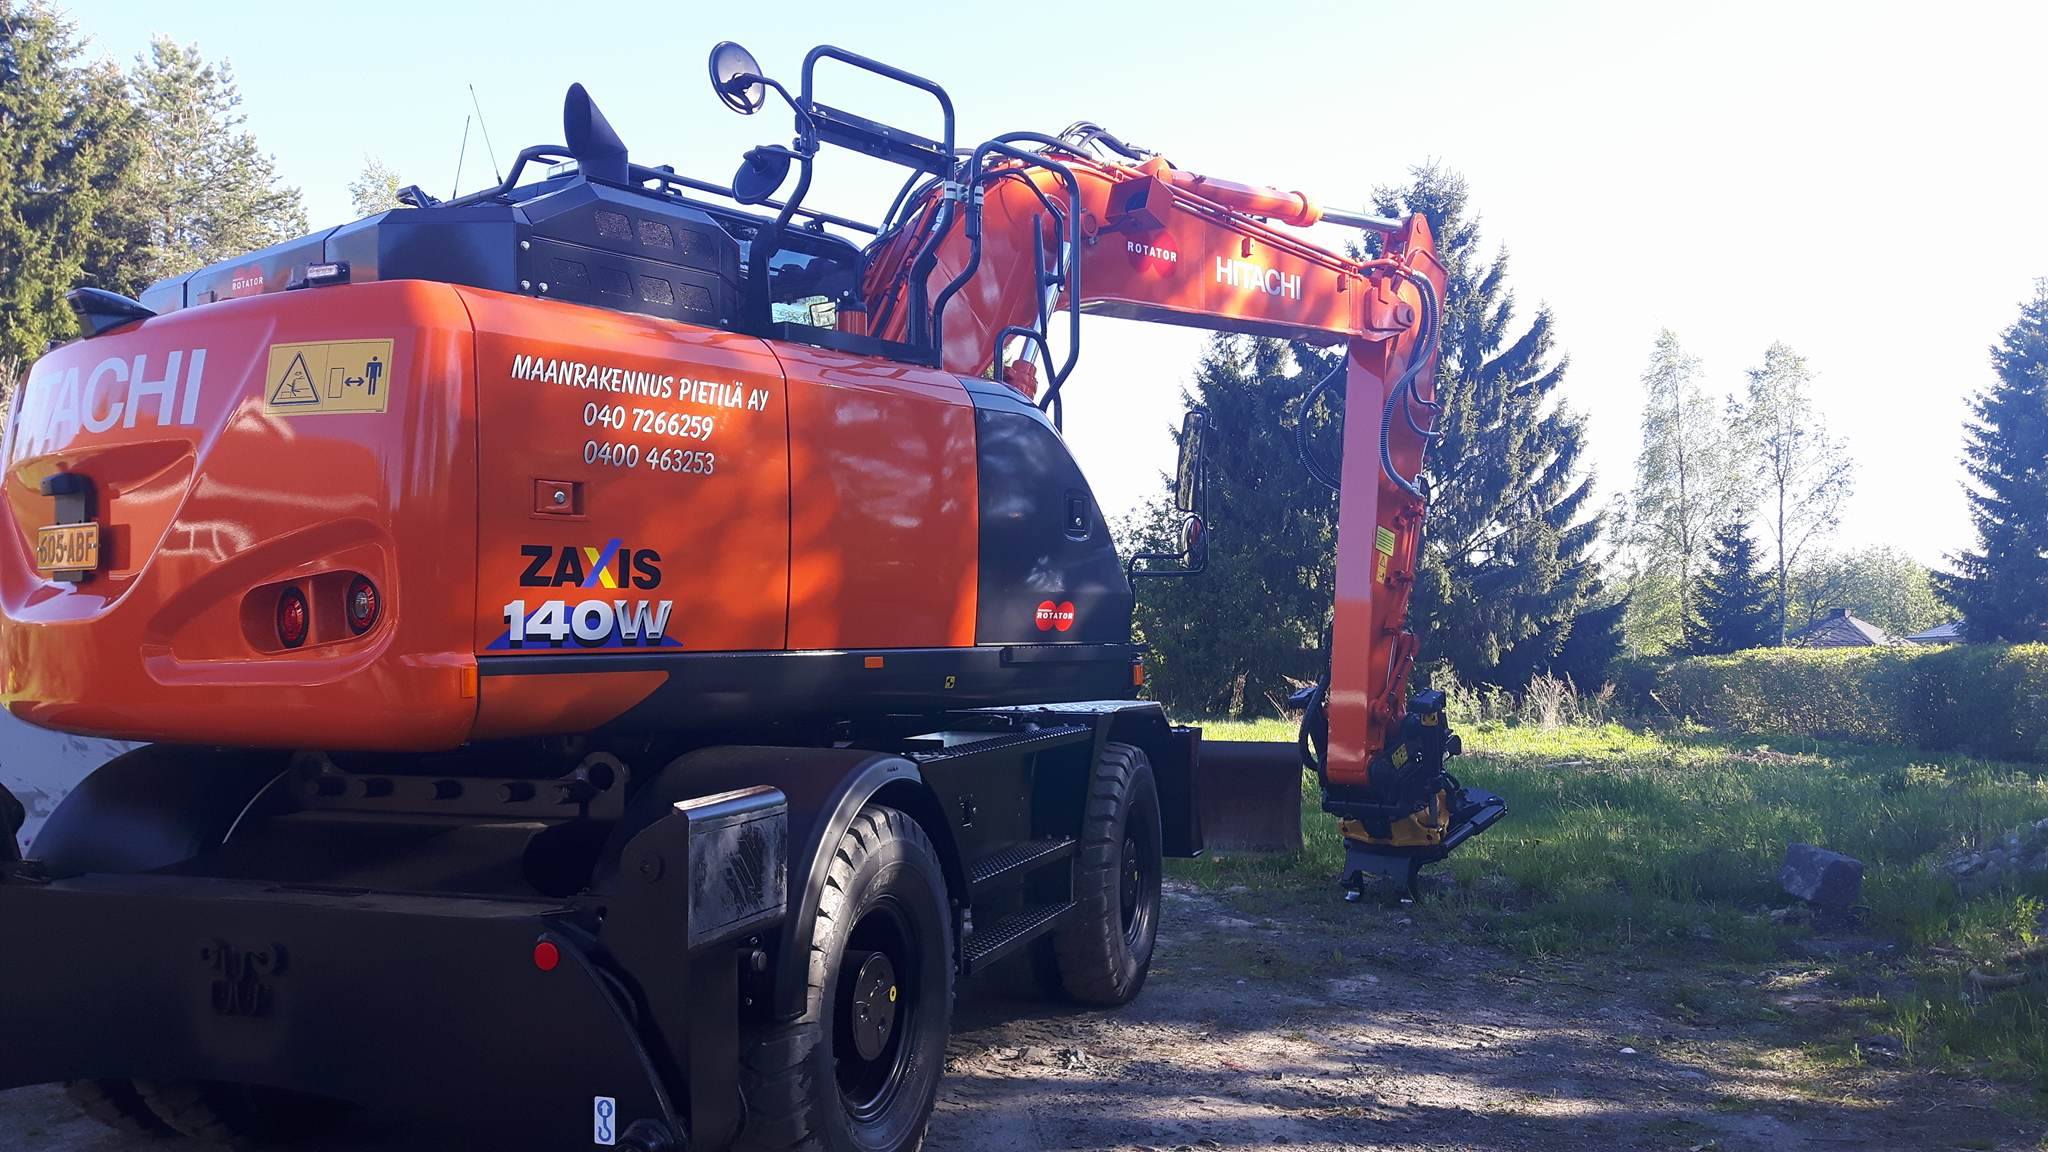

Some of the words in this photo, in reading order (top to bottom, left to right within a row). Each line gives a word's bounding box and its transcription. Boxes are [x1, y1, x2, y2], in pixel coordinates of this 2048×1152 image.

[1127, 240, 1177, 262] ROTATOR
[232, 276, 264, 291] ROTATOR
[1215, 255, 1301, 300] HITACHI
[511, 354, 674, 399] MAANRAKENNUS
[679, 380, 743, 409] PIETILÄ
[747, 389, 769, 412] AY
[584, 402, 626, 429] 040
[632, 408, 714, 441] 7266259
[584, 440, 639, 468] 0400
[645, 447, 715, 475] 463253
[519, 538, 662, 589] ZAXIS
[503, 600, 673, 646] 140W
[1036, 611, 1073, 620] ROTATOR
